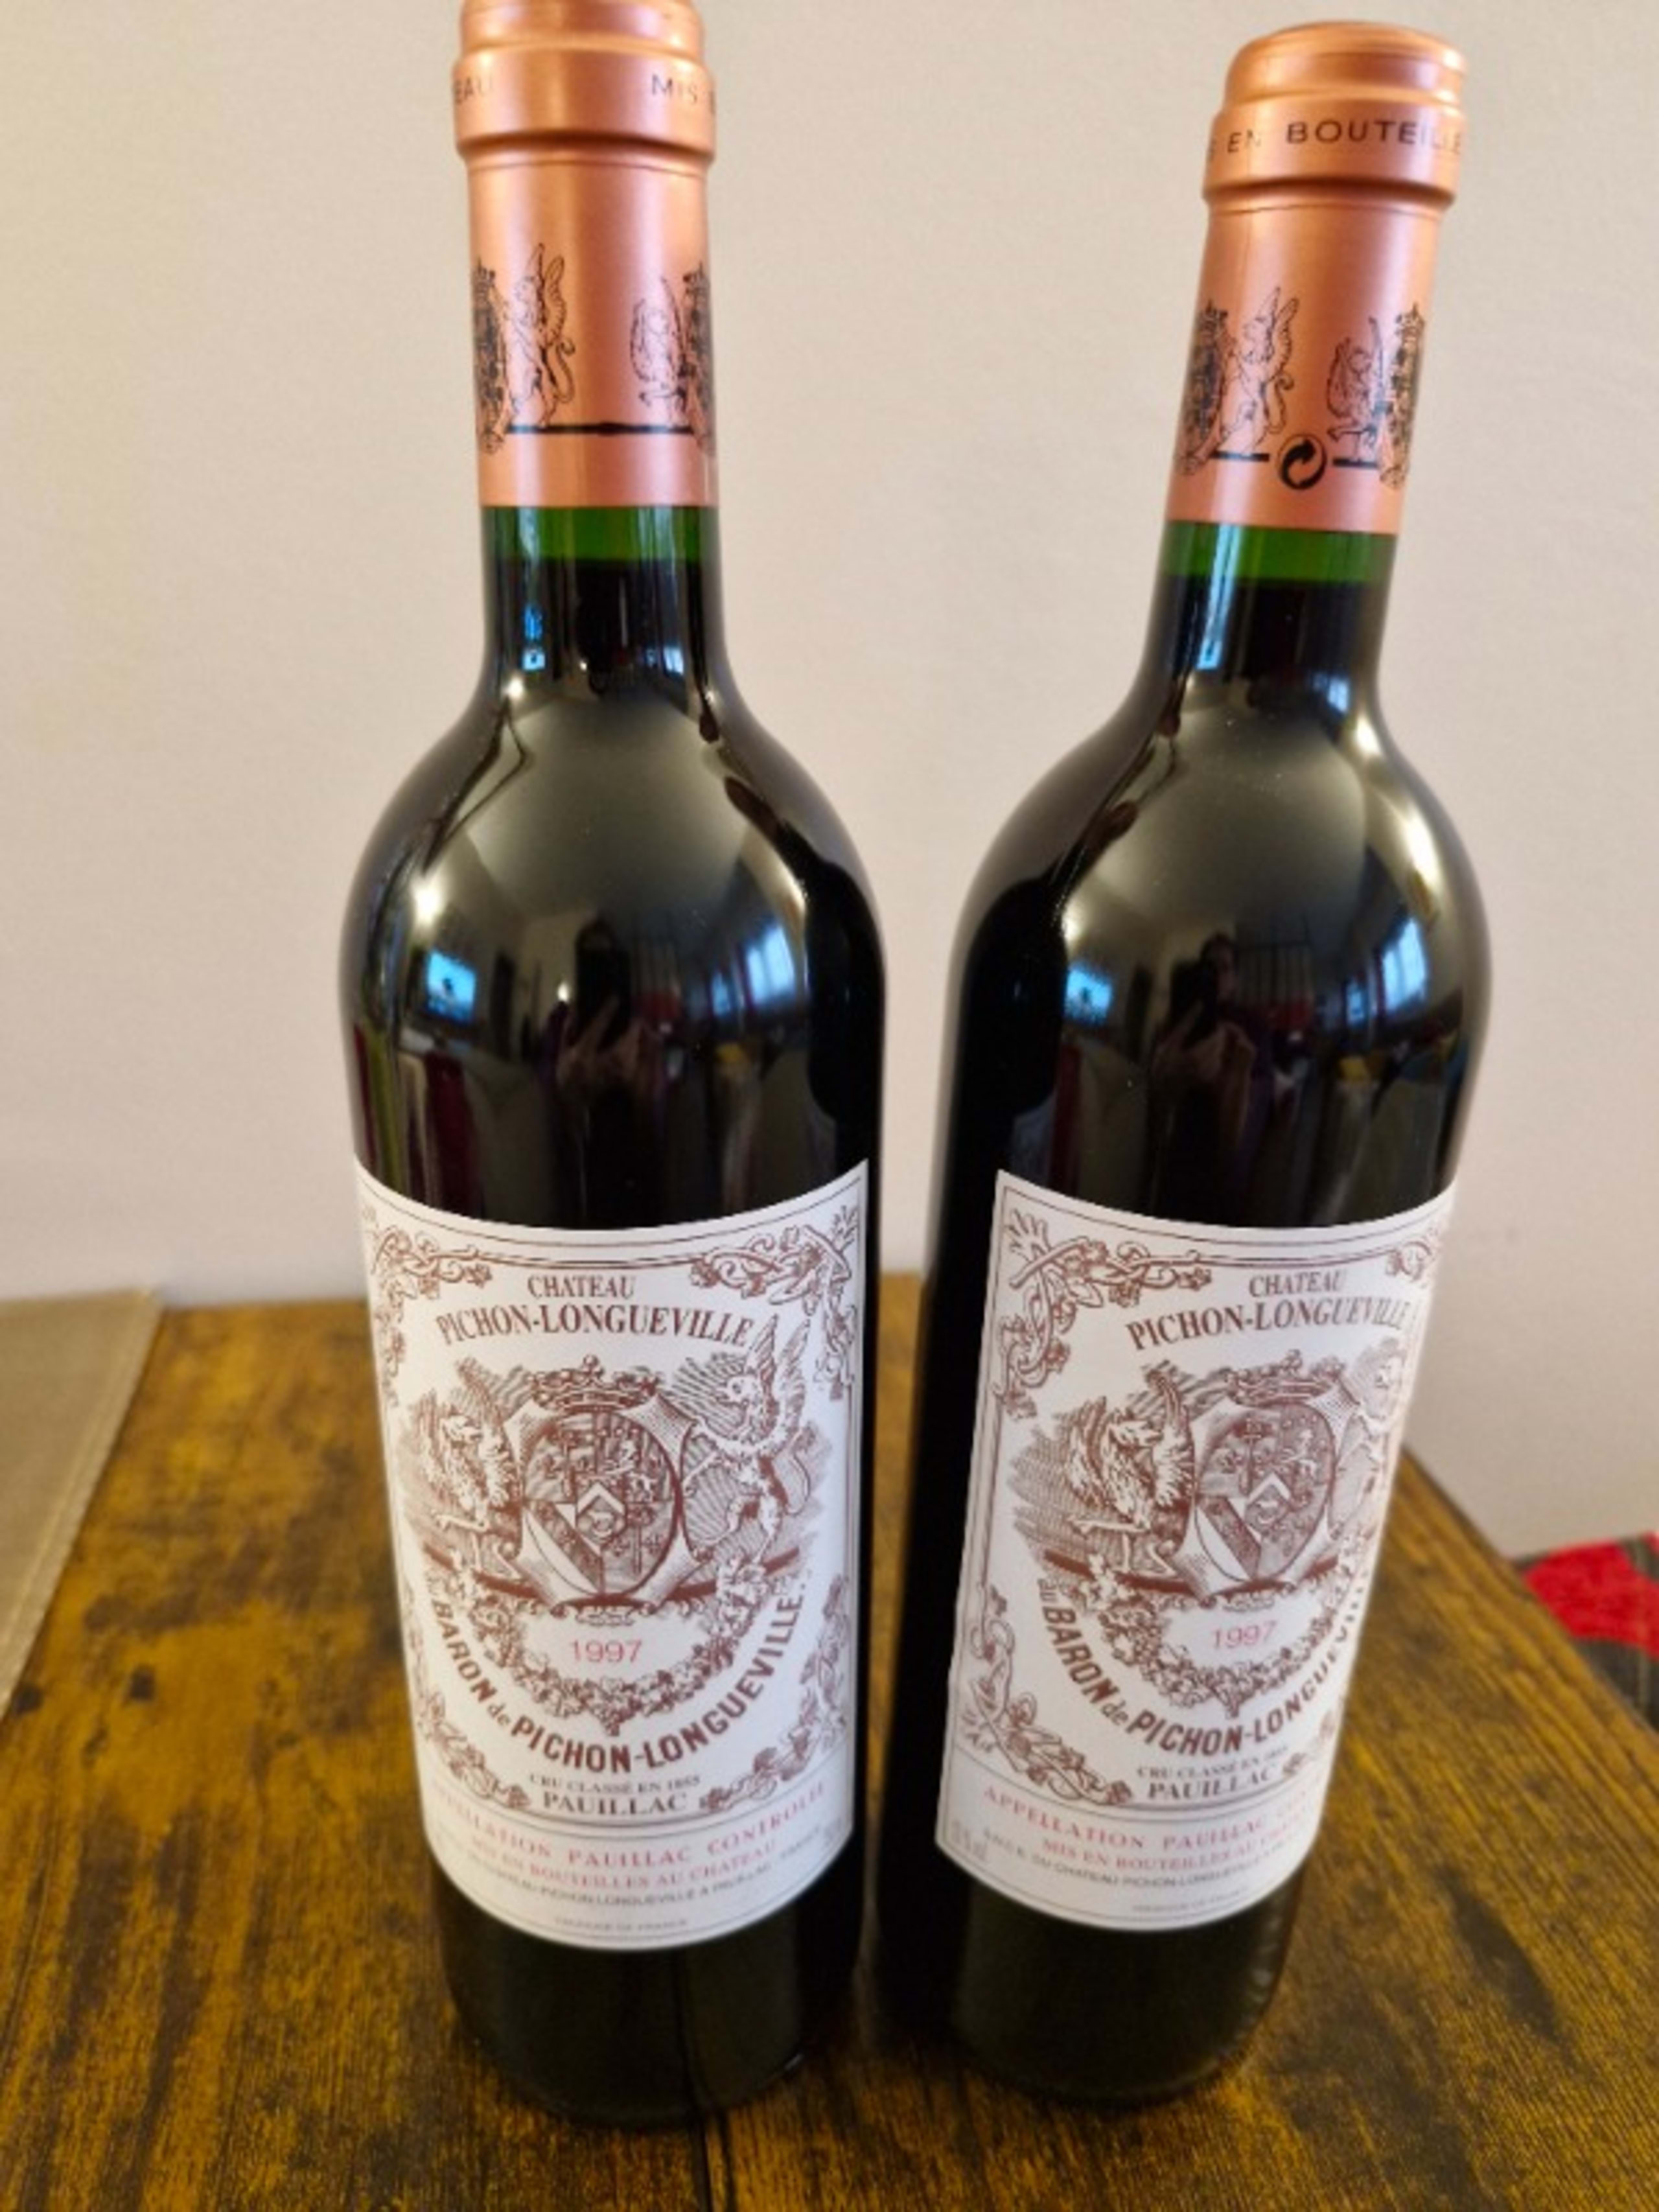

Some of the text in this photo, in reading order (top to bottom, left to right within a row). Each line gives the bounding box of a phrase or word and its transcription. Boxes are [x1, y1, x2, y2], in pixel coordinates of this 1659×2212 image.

[1227, 129, 1262, 154] EN
[526, 1274, 637, 1299] CHATEAU
[1249, 1270, 1348, 1298] CHATEAU
[435, 1303, 756, 1347] PICHON-LONGUEVILLE
[1212, 1620, 1277, 1650] 1997
[430, 1598, 498, 1703] BARON
[487, 1701, 511, 1727] de
[570, 1638, 644, 1664] 1997
[1042, 1606, 1120, 1704] BARON
[1101, 1699, 1129, 1725] de
[1148, 1768, 1270, 1799] PAUILLAC
[543, 1791, 688, 1815] PAUILLAC
[984, 1786, 1147, 1848] APPELLATION
[567, 1847, 690, 1869] PAUILLAC
